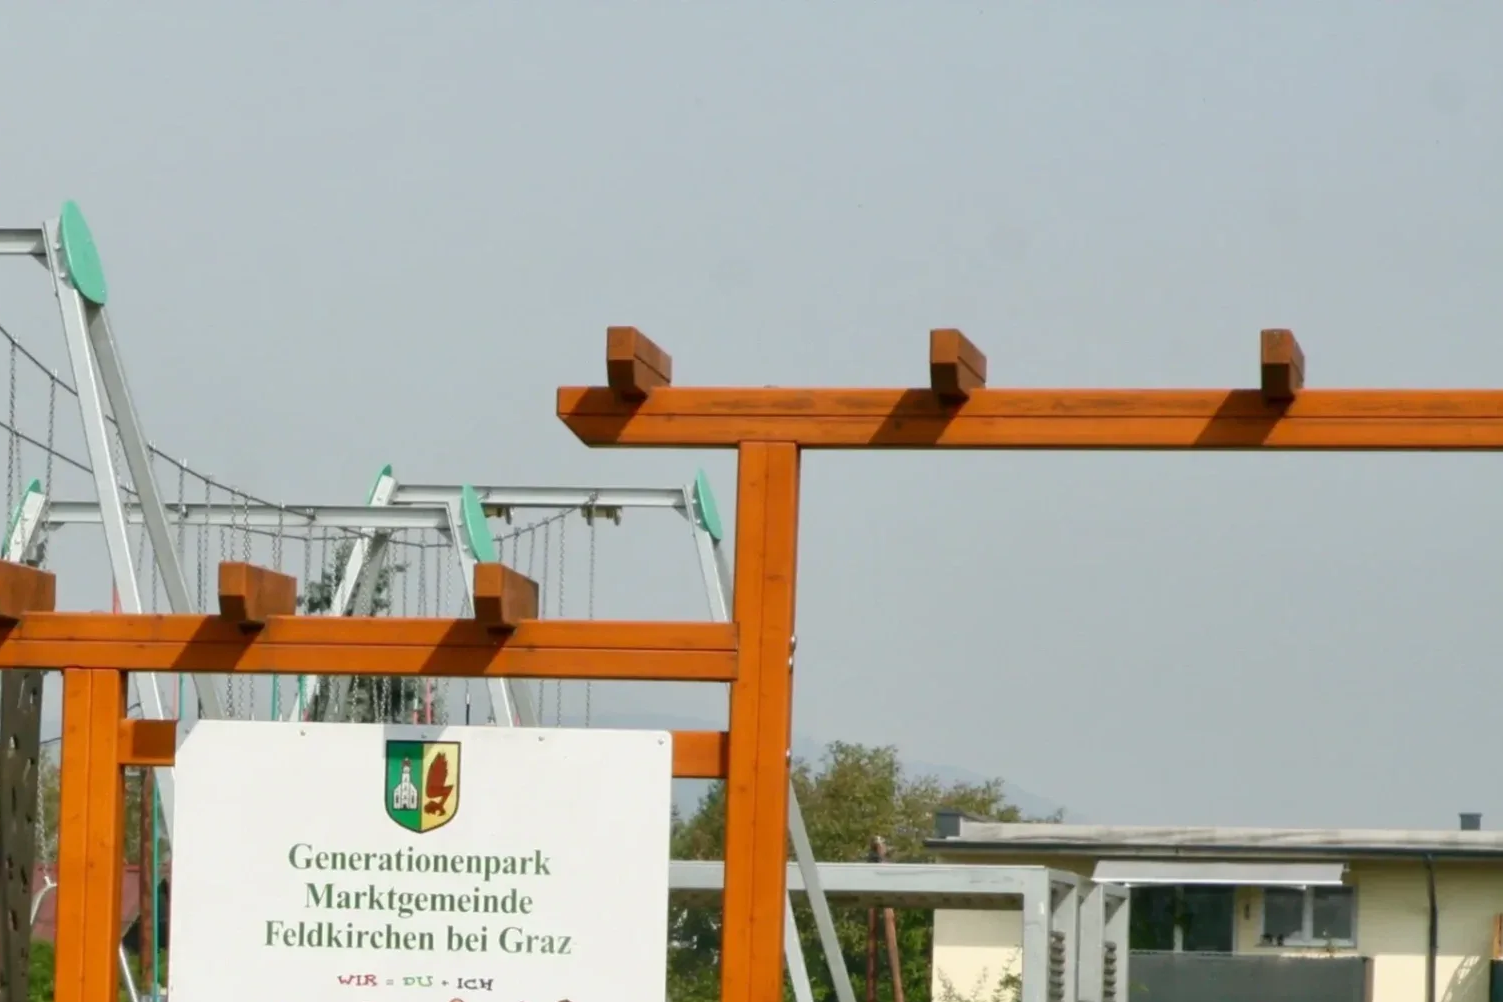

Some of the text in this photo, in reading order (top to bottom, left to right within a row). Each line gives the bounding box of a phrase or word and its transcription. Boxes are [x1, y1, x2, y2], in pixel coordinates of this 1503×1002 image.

[288, 842, 551, 881] Generationenpark
[304, 881, 534, 918] Marktgemeinde
[264, 919, 572, 956] Feldkirchen bei Graz
[337, 974, 378, 987] WIR
[403, 976, 434, 988] DU
[457, 977, 495, 991] ICH
